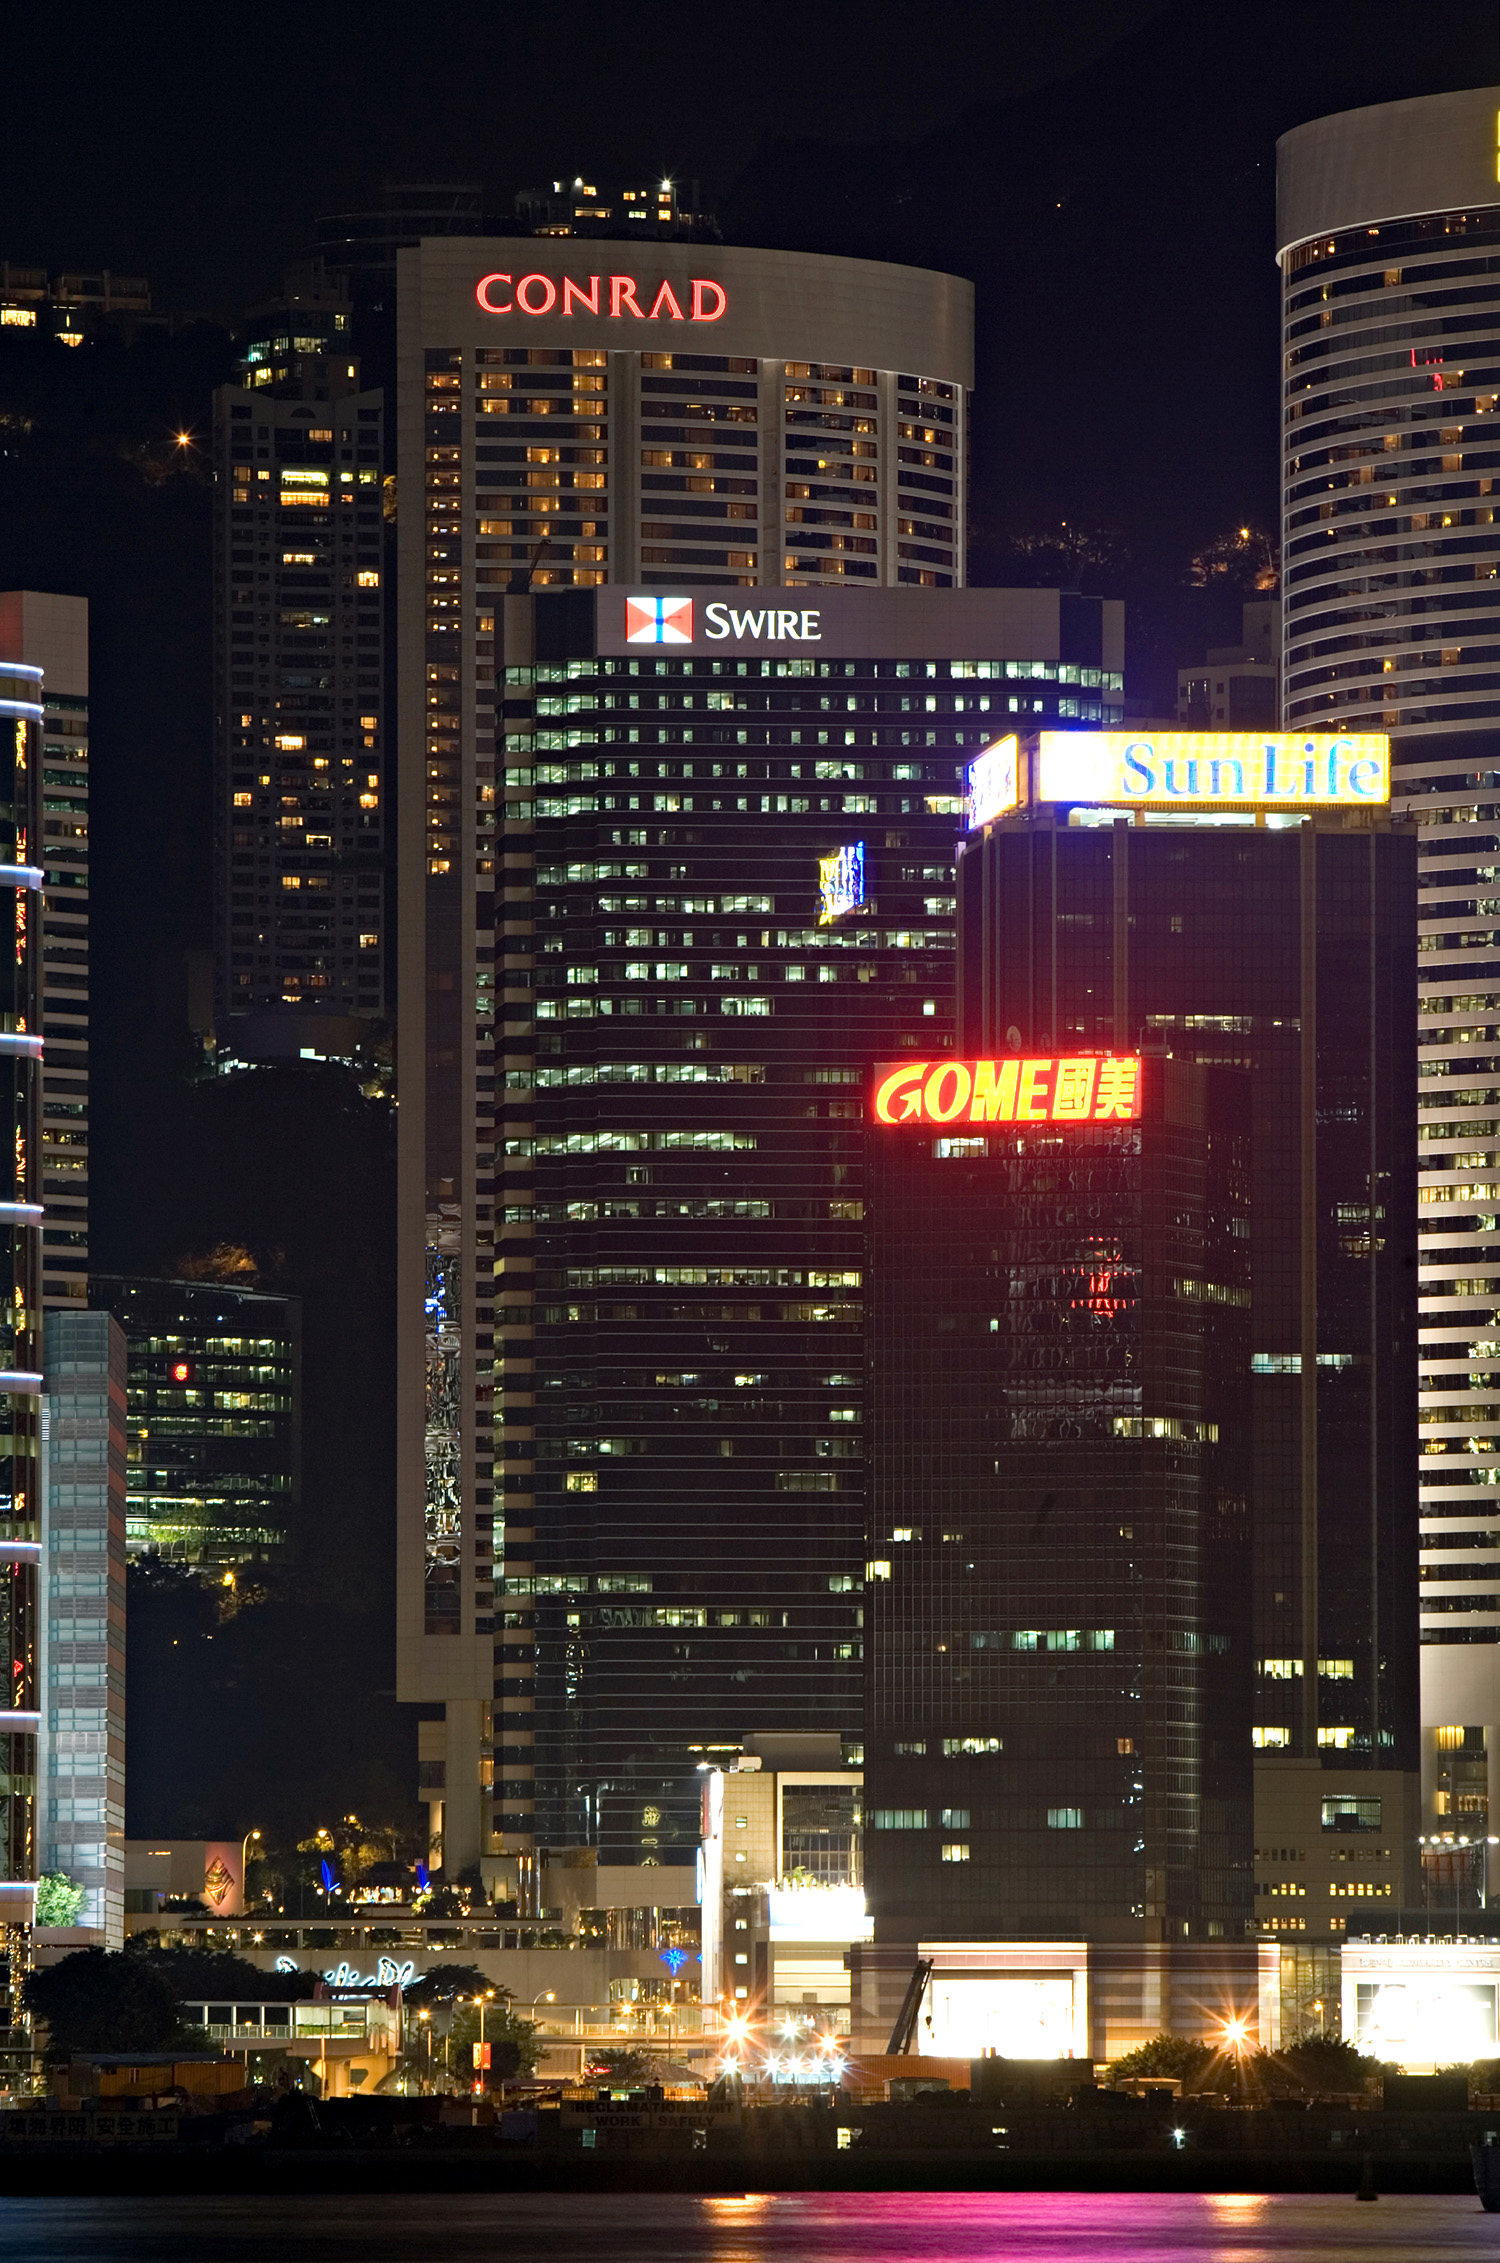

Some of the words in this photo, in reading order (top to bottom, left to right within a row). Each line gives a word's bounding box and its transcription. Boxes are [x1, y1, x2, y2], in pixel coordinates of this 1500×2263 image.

[476, 273, 728, 322] CONRAD
[1123, 743, 1244, 795] Sun
[1264, 740, 1381, 795] Life
[576, 2102, 687, 2113] RECLAMATION
[695, 2102, 734, 2113] LIMIT
[596, 2116, 641, 2127] WORK
[658, 2116, 715, 2127] SAFELY
